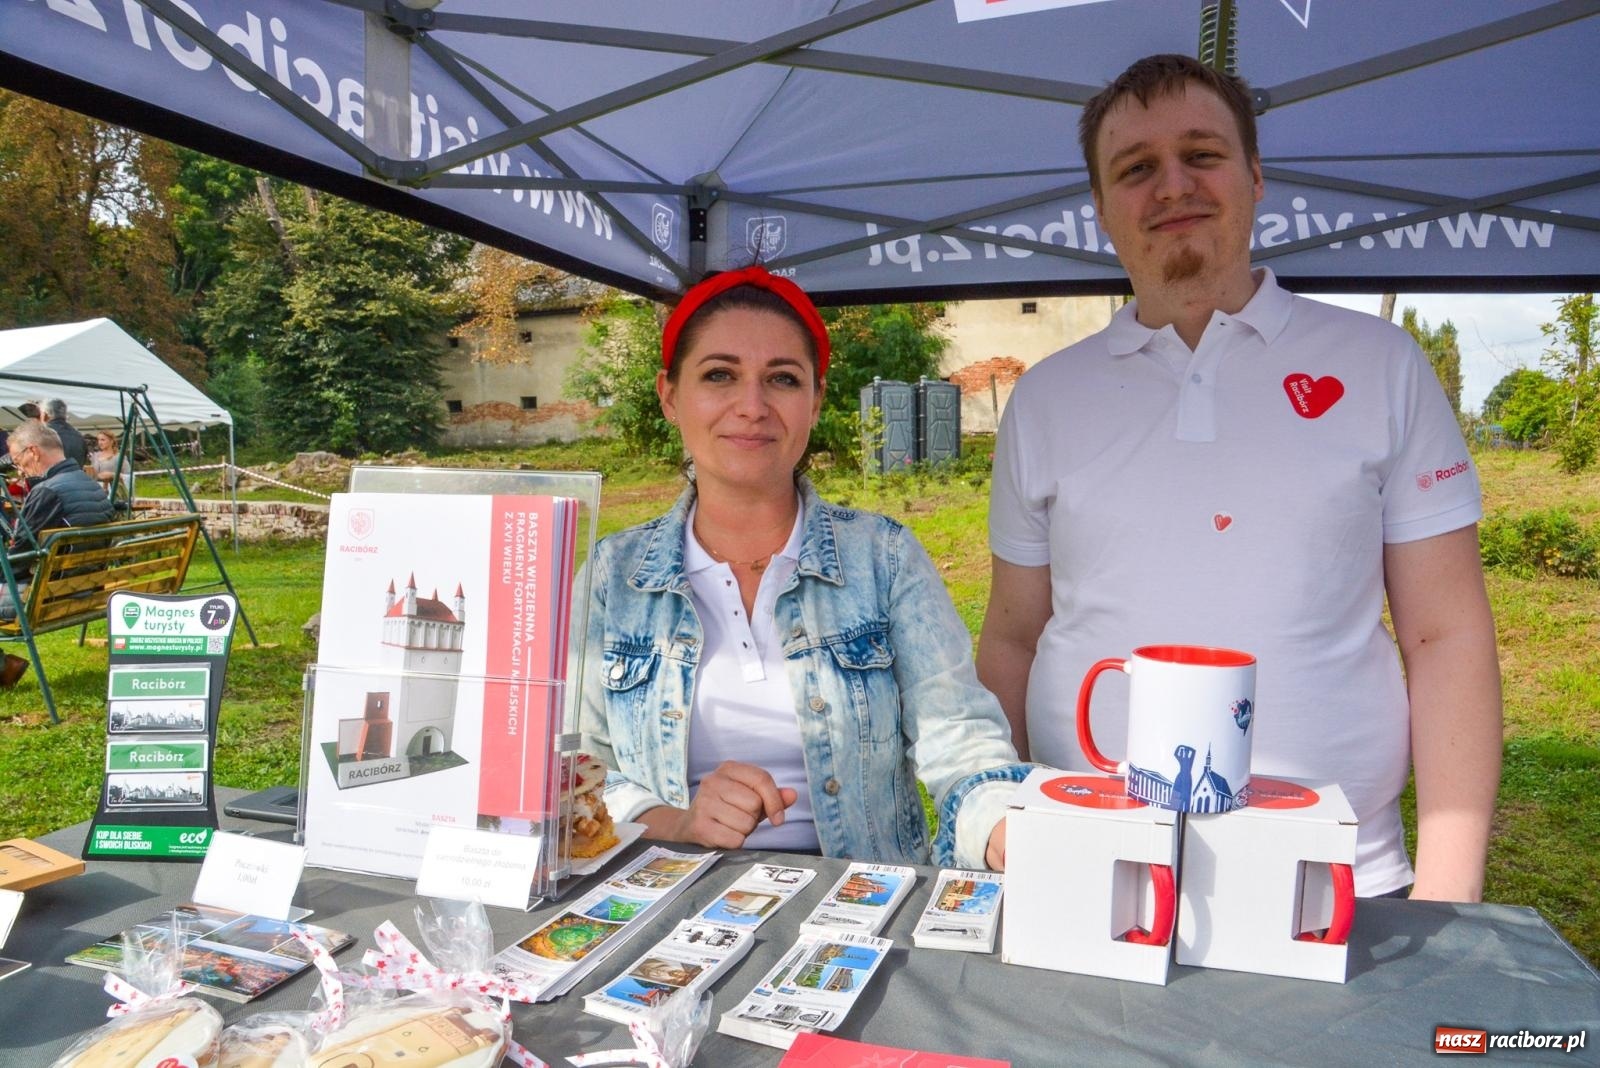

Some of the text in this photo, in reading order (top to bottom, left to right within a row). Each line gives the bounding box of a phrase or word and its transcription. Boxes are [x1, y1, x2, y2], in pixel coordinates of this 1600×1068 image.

[1300, 378, 1311, 394] Visit
[1290, 381, 1309, 413] Racibórz
[339, 544, 379, 554] RACIBÓRZ
[502, 511, 514, 584] Z XVI WIEKU
[524, 512, 538, 642] BASZTA WIĘZIENNA
[145, 605, 196, 620] Magnes
[144, 620, 185, 634] turysty
[507, 512, 526, 736] FRAGMENT FORTYFIKACJI MIEJSKICH
[129, 644, 203, 653] www.magnesturysty.pl
[132, 677, 186, 690] Racibórz
[129, 750, 184, 763] Racibórz
[348, 763, 402, 779] RACIBÓRZ
[95, 830, 143, 841] KUP DLA SIEBIE
[179, 829, 207, 844] eco
[99, 840, 123, 849] SWOICH
[123, 841, 152, 850] BLISKICH
